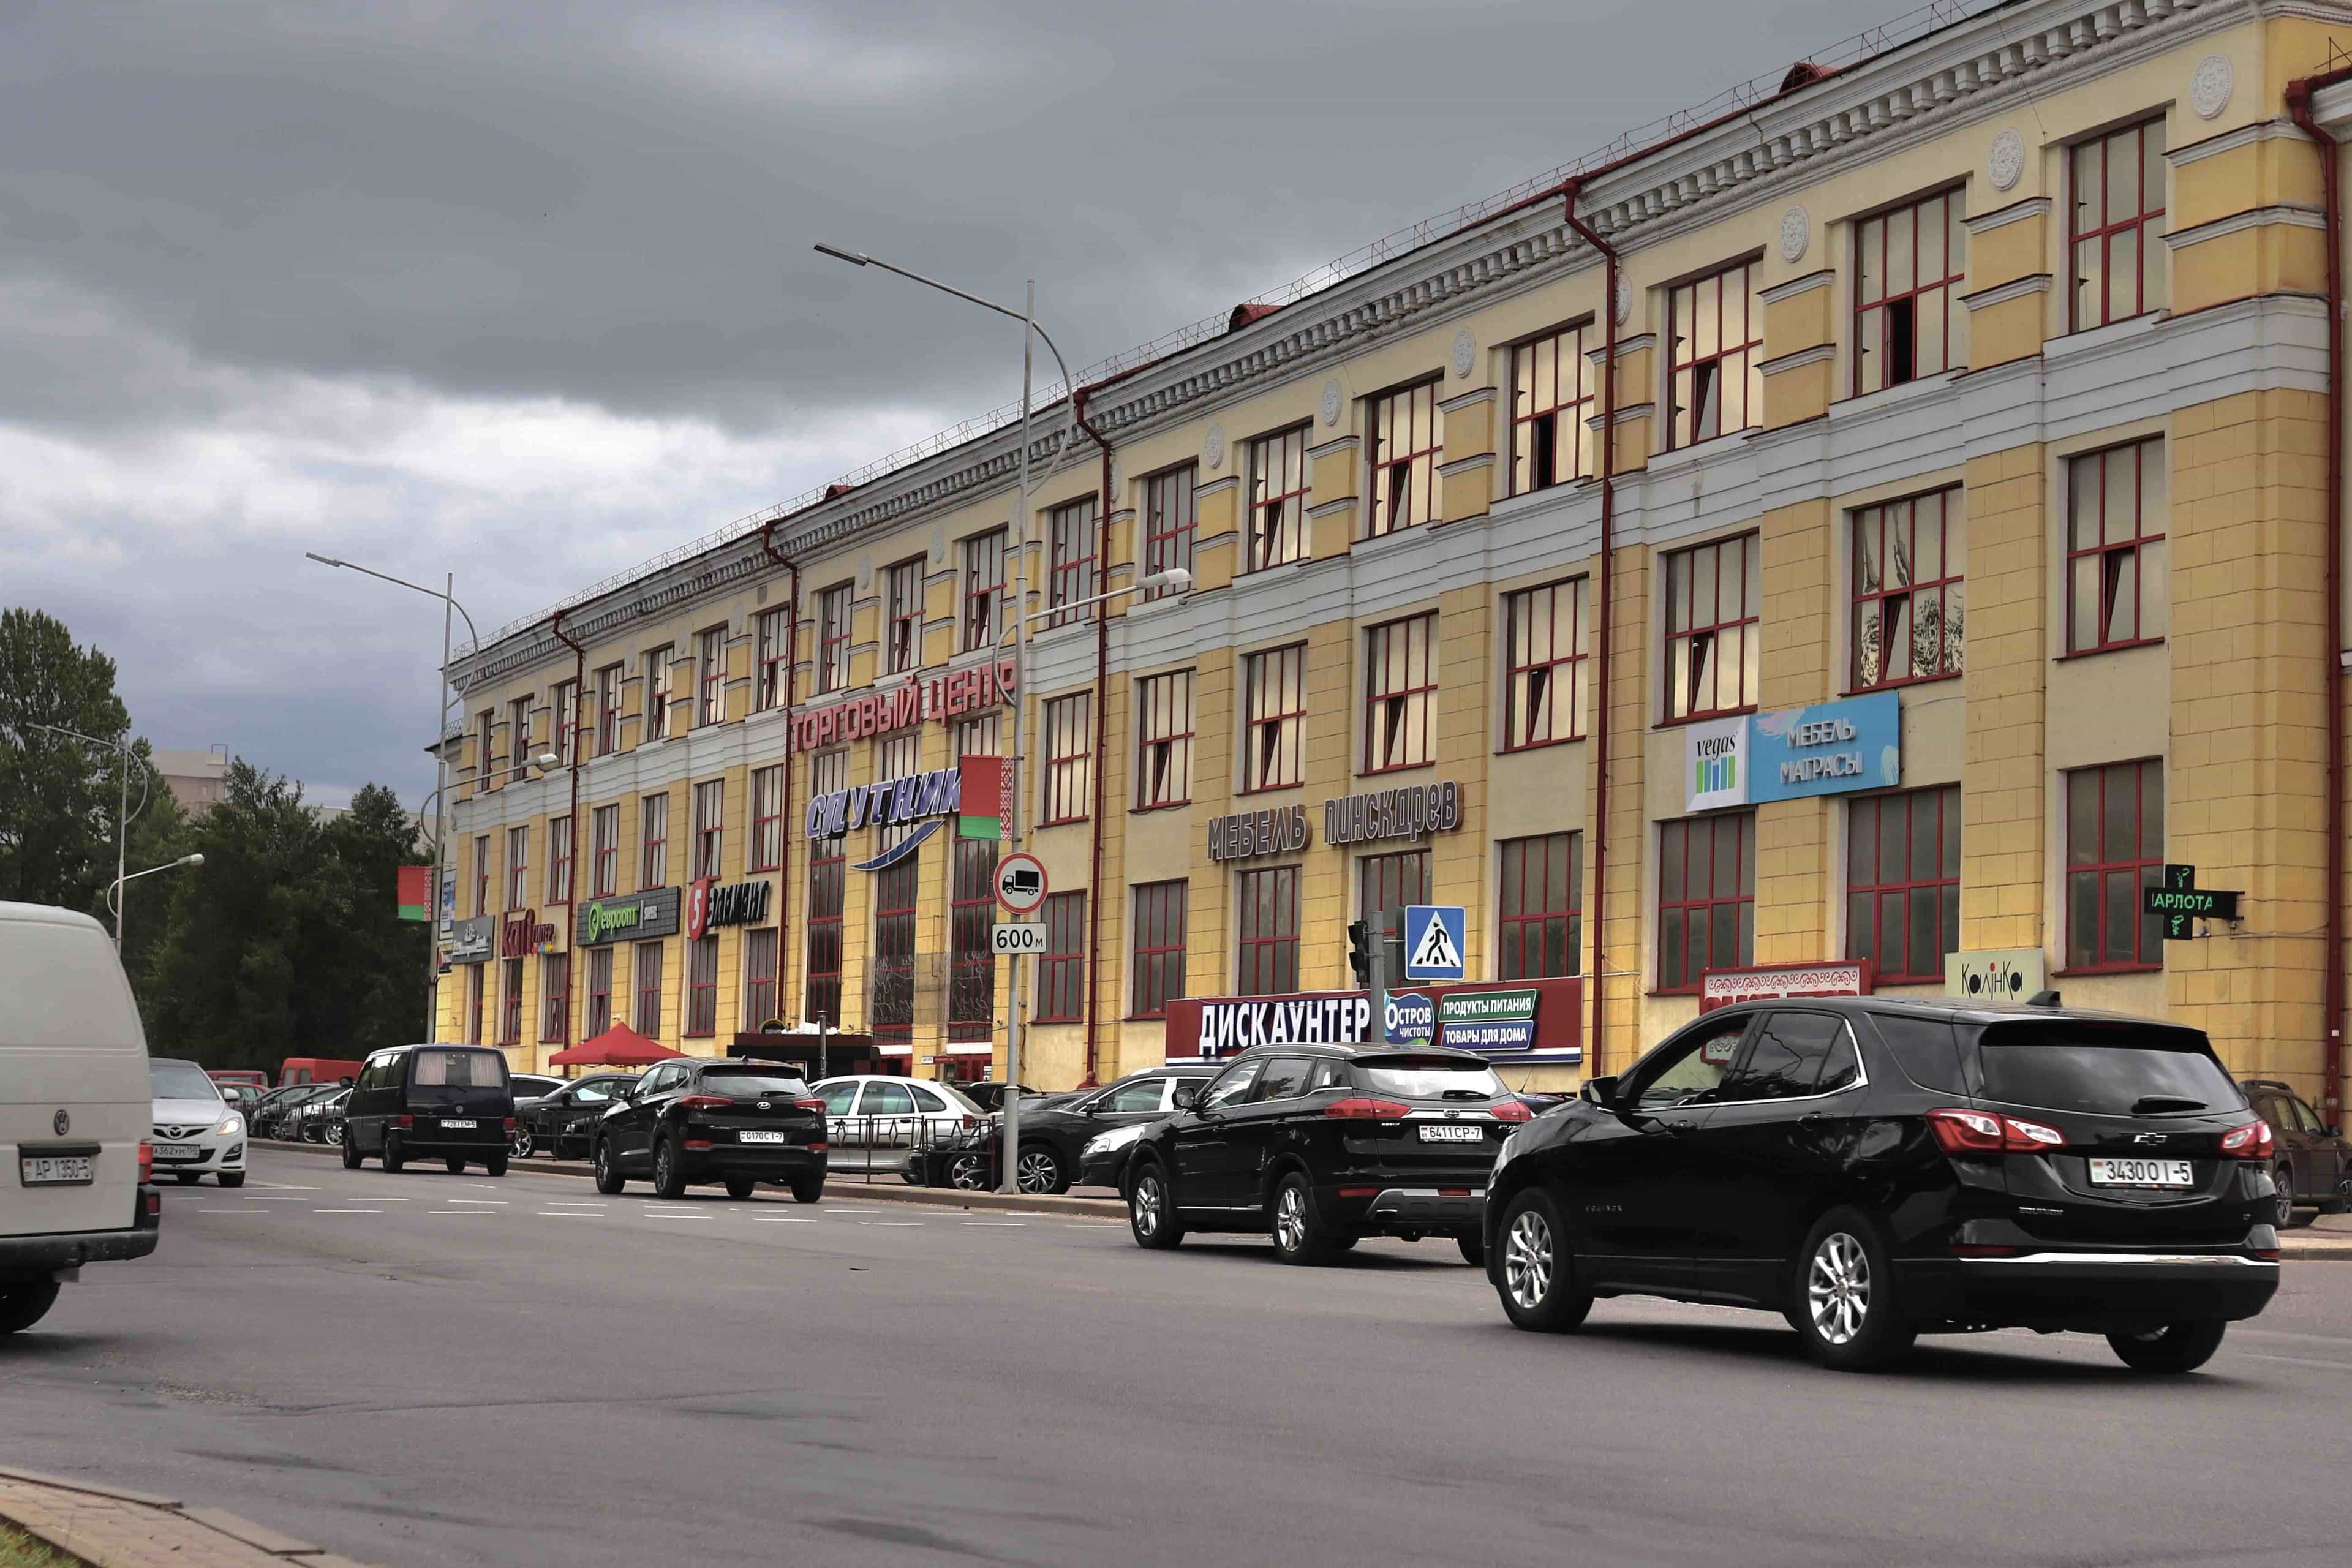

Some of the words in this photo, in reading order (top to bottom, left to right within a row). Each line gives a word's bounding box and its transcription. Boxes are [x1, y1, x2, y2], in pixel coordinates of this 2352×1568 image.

[791, 676, 921, 752] ТОРГОВЫЙ
[929, 660, 1017, 727] ЦЕНТР
[1696, 734, 1736, 760] vegas
[1788, 717, 1856, 750] МЕБЕЛЬ
[1781, 751, 1863, 785] МАТРАСЫ
[1207, 804, 1307, 861] МЕБЕЛЬ
[691, 889, 703, 930] 5
[1443, 1000, 1490, 1017] ПРОДУКТЫ
[1491, 997, 1531, 1013] ПИТАНИЯ
[1199, 998, 1371, 1055] ДИСКАУНТЕР
[1446, 1030, 1479, 1044] ТОВАРЫ
[1480, 1030, 1499, 1044] ДЛЯ
[1499, 1027, 1527, 1044] ДОМА
